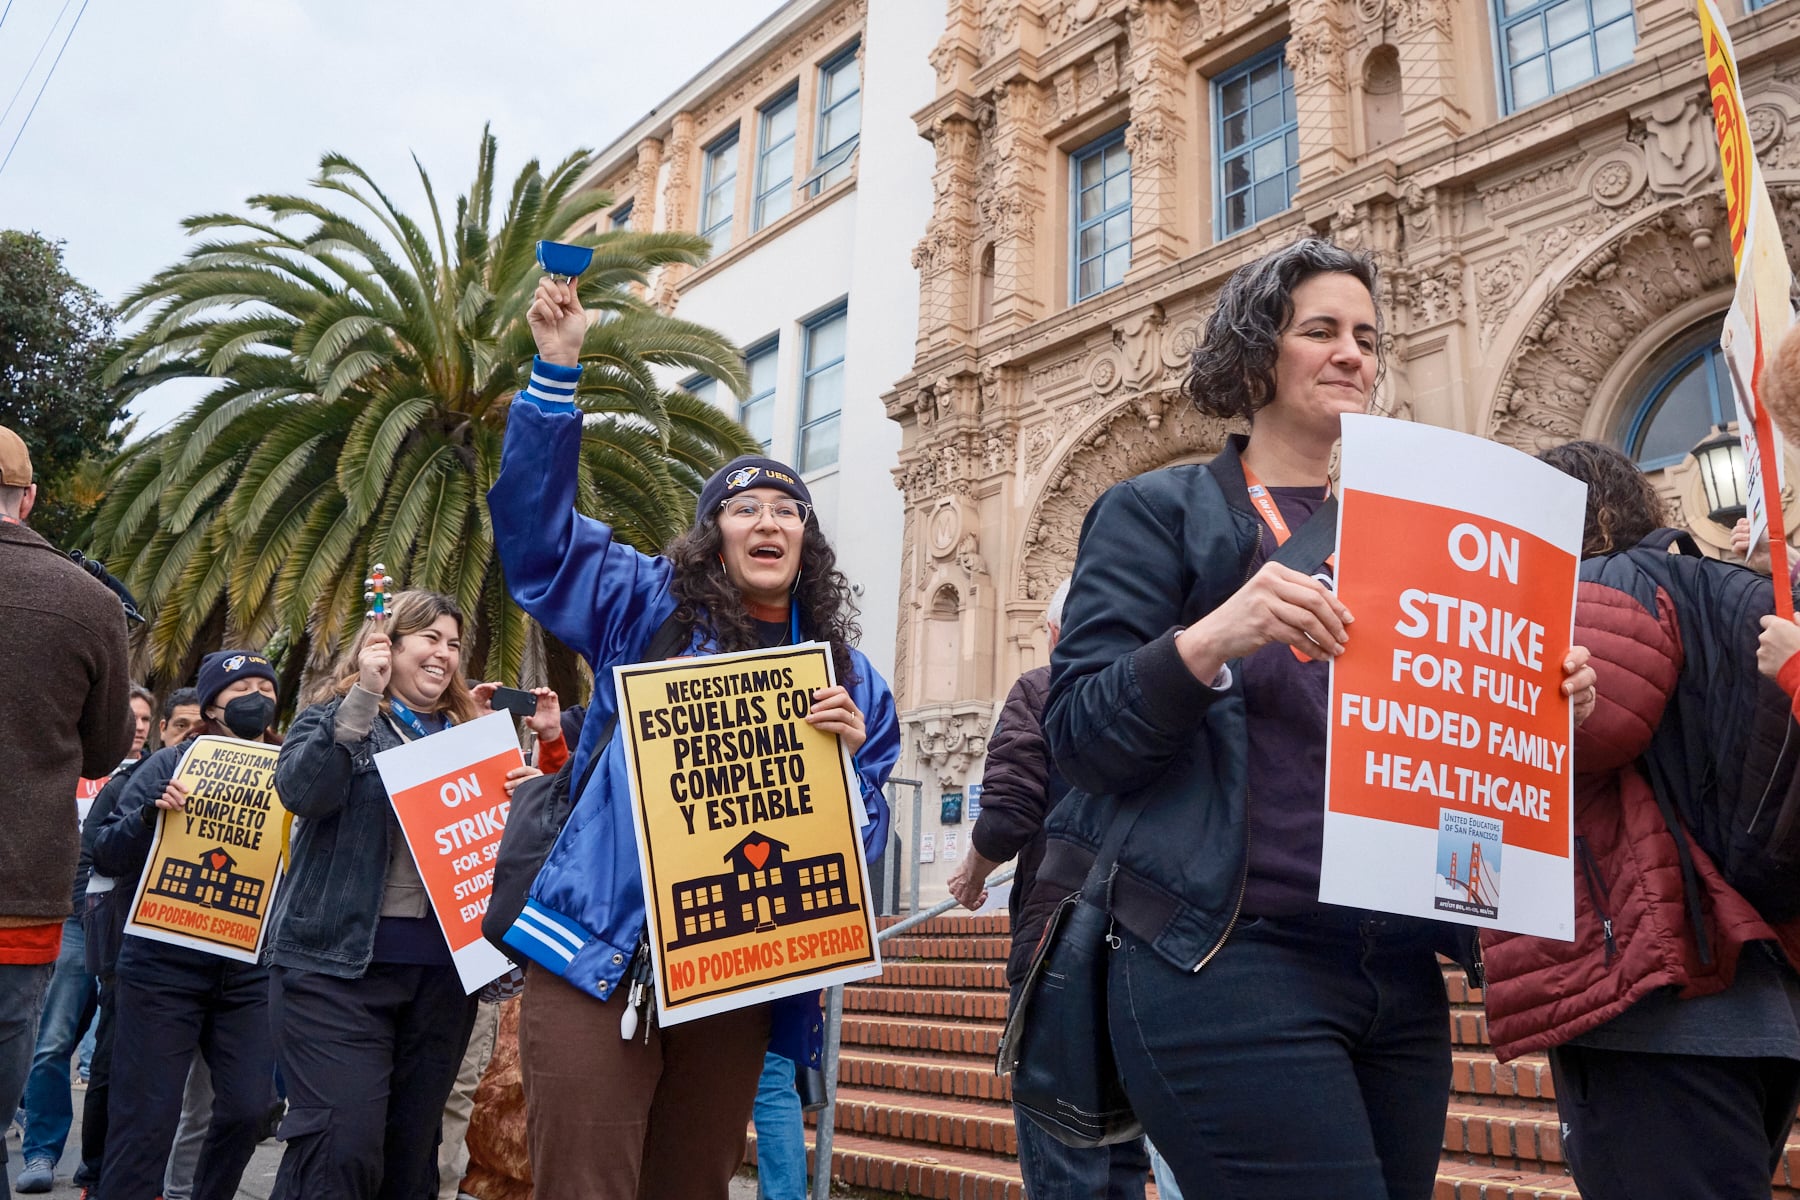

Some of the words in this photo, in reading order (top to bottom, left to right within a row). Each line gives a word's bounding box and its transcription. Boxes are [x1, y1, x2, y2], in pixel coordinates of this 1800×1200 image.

[1448, 523, 1519, 585] ON
[1394, 588, 1545, 672] STRIKE
[665, 667, 794, 704] NECESITAMOS
[1392, 649, 1464, 694] FOR
[1472, 665, 1542, 716] FULLY
[639, 695, 768, 742] ESCUELAS
[1341, 693, 1481, 749] FUNDED
[1488, 721, 1566, 774] FAMILY
[673, 722, 804, 770] PERSONAL
[186, 758, 263, 787] ESCUELAS
[193, 779, 272, 811] PERSONAL
[440, 772, 482, 808] ON
[670, 754, 805, 803] COMPLETO
[1365, 750, 1551, 822] HEALTHCARE
[184, 796, 266, 830] COMPLETO
[185, 815, 195, 835] Y
[198, 818, 263, 851] ESTABLE
[679, 804, 695, 835] Y
[706, 784, 814, 831] ESTABLE
[452, 851, 483, 875] FOR
[482, 840, 501, 862] SP
[453, 867, 496, 901] STUDE
[139, 901, 157, 918] NO
[157, 904, 210, 931] PODEMOS
[210, 917, 257, 943] ESPERAR
[670, 960, 696, 991] NO
[698, 940, 785, 984] PODEMOS
[786, 924, 865, 963] ESPERAR
